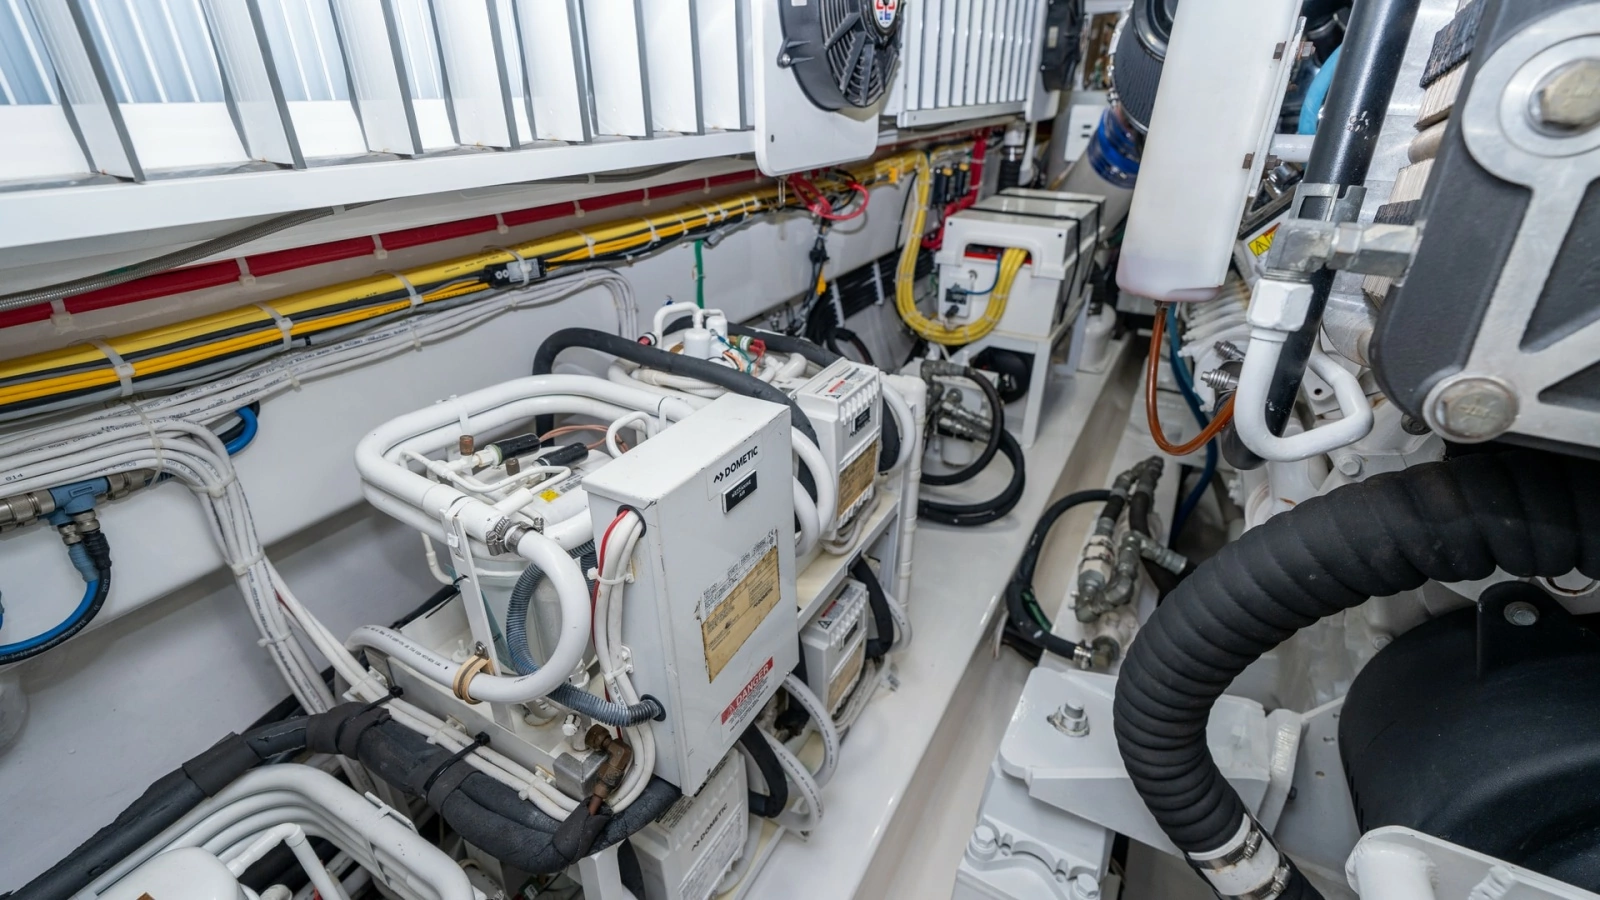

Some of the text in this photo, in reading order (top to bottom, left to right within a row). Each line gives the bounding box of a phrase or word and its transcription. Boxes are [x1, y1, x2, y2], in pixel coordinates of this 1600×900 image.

[724, 445, 758, 478] DOMETIC
[735, 664, 769, 706] DANGER
[699, 802, 728, 841] DOMETIC
